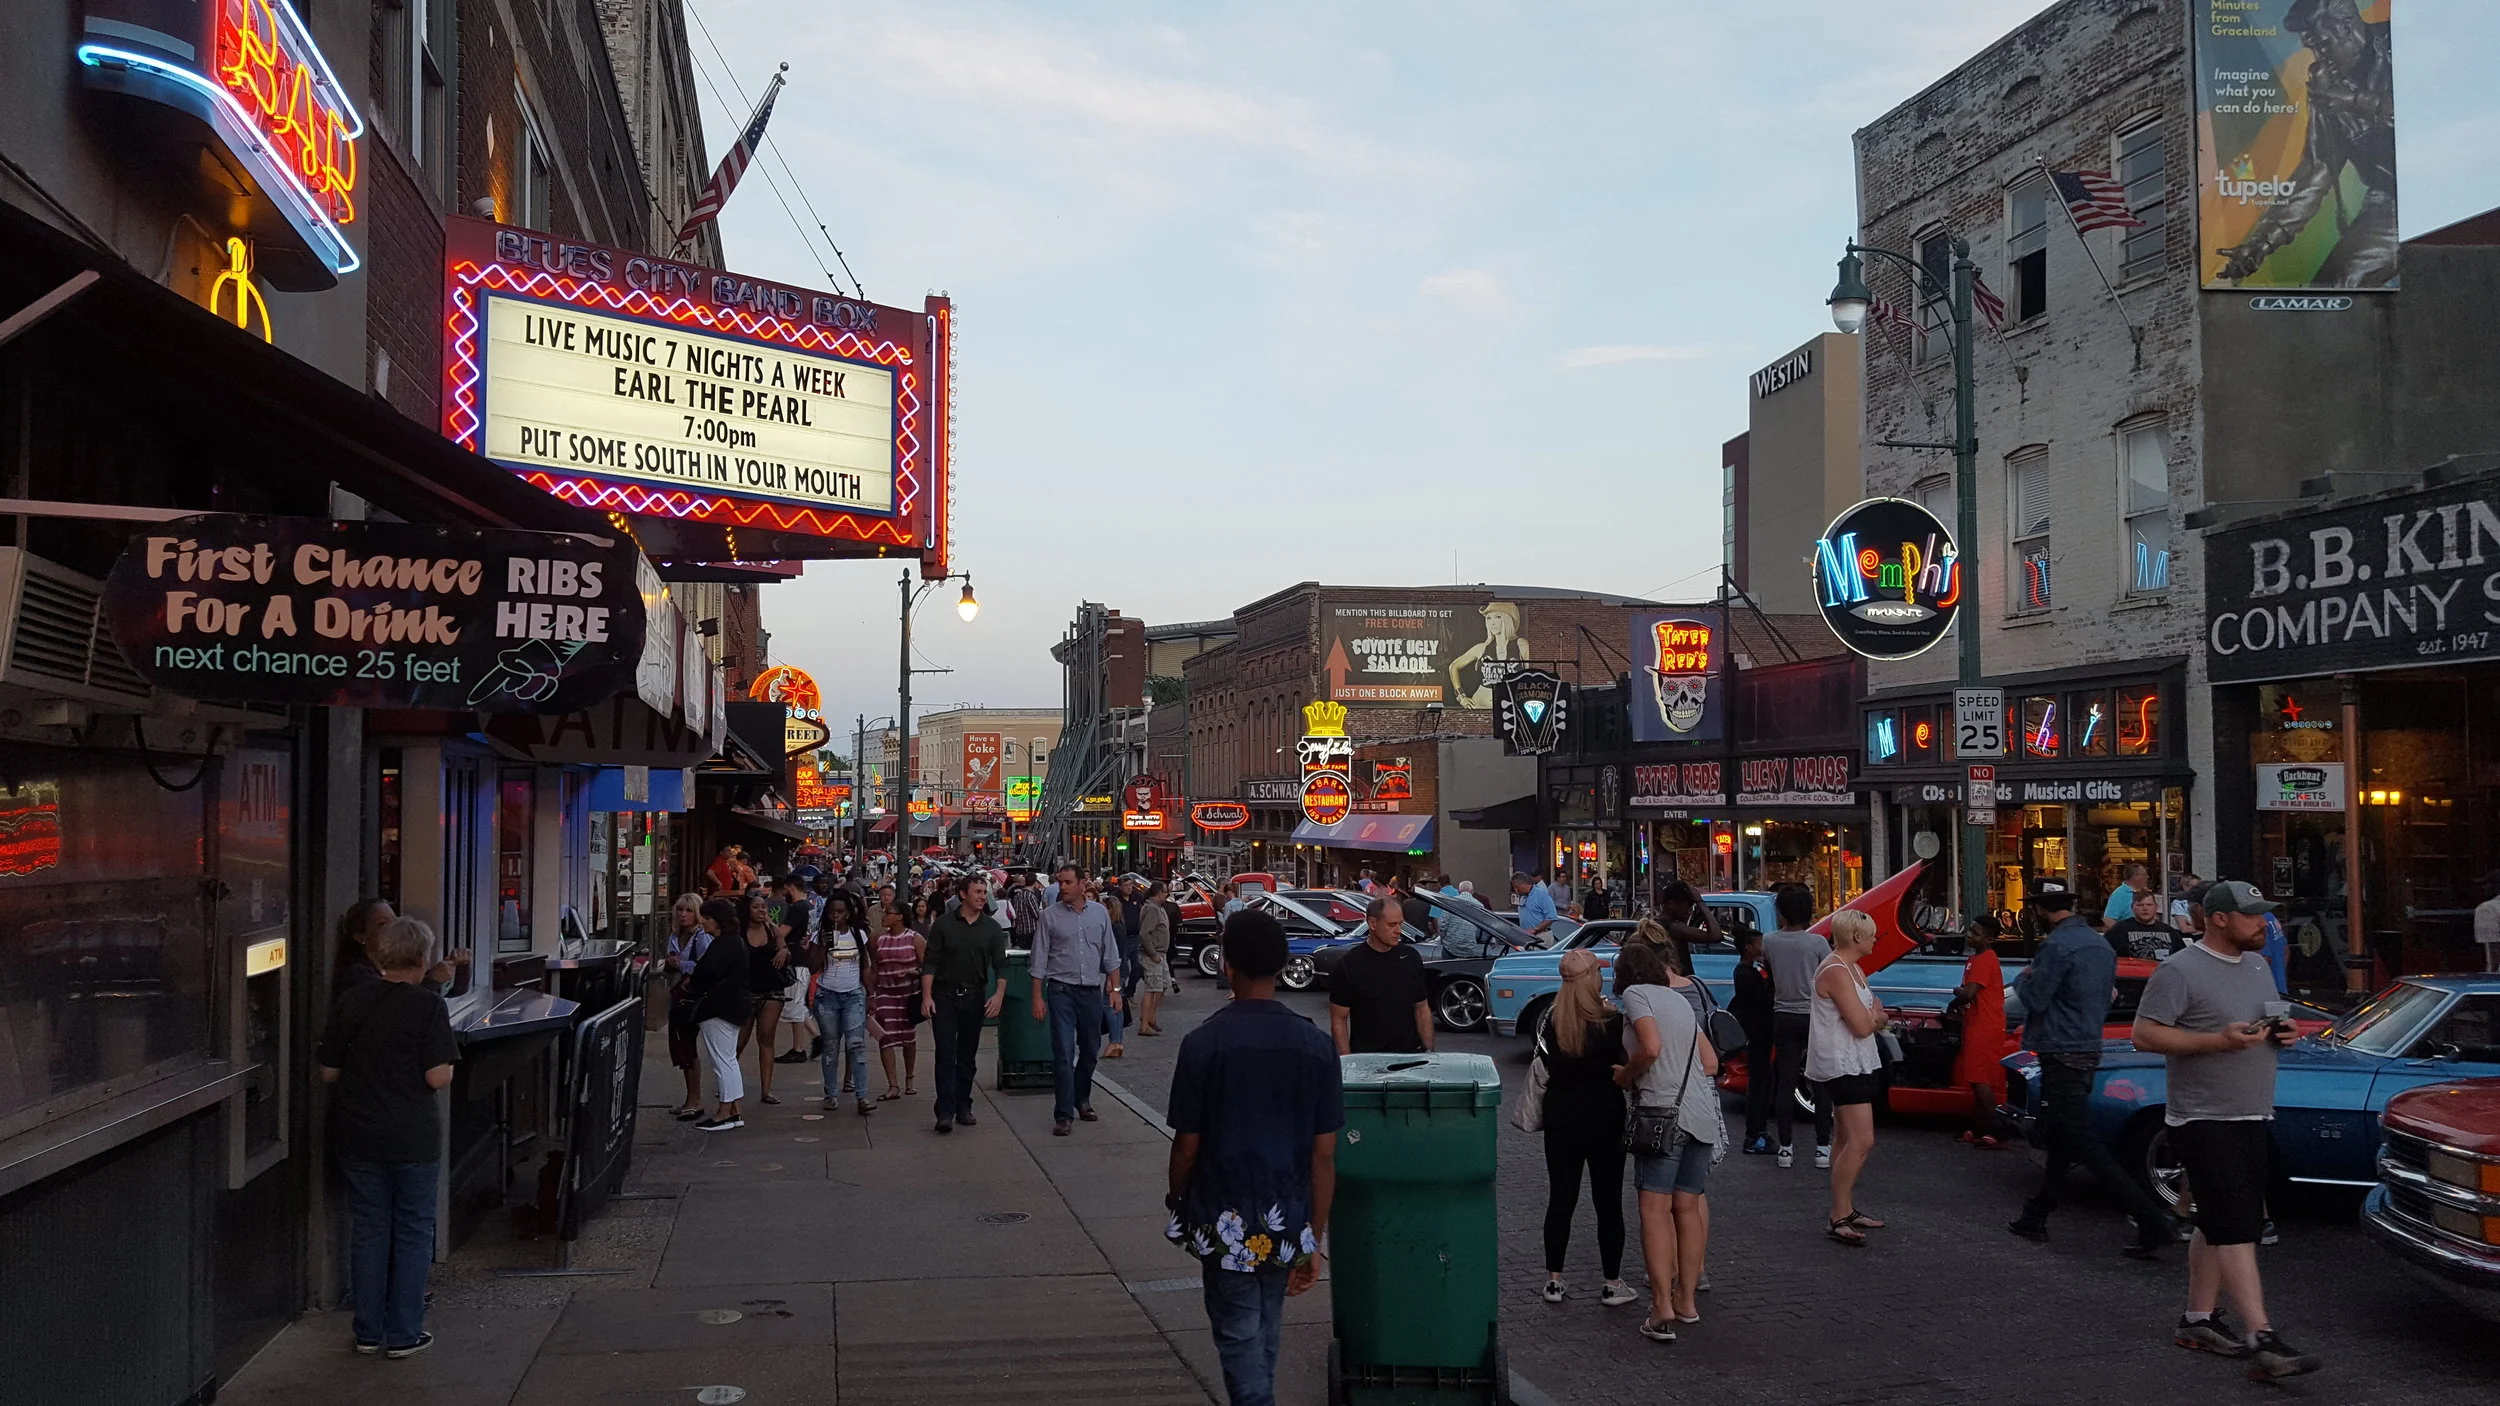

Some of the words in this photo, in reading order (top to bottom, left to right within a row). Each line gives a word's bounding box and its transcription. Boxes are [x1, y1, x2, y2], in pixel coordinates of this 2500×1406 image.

[2211, 13, 2241, 24] from
[2211, 25, 2277, 37] Graceland
[2214, 68, 2269, 83] Imagine
[2215, 85, 2249, 97] what
[2252, 87, 2276, 98] you
[2215, 103, 2239, 113] can
[2243, 101, 2260, 113] do
[2263, 101, 2299, 114] here!
[2215, 170, 2296, 206] tupelo
[495, 230, 614, 283] BLUES
[625, 257, 700, 299] CITY
[711, 276, 803, 320] BAND
[812, 297, 878, 337] BOX
[2258, 298, 2343, 310] LAMAR
[524, 315, 576, 351] LIVE
[584, 324, 657, 368] MUSIC
[664, 341, 678, 368] 7
[686, 343, 764, 386] NIGHTS
[770, 360, 785, 389] A
[792, 364, 846, 400] WEEK
[1755, 350, 1812, 399] WESTIN
[613, 367, 677, 404] EARL
[684, 378, 734, 416] THE
[741, 388, 813, 428] PEARL
[683, 415, 757, 448] 7:00pm
[520, 425, 561, 461] PUT
[568, 432, 628, 469] SOME
[634, 442, 702, 481] SOUTH
[707, 453, 728, 484] IN
[734, 457, 788, 492] YOUR
[794, 466, 862, 501] MOUTH
[146, 535, 276, 585] First
[293, 542, 483, 597] Chance
[1815, 532, 1962, 608] Memphis
[2249, 526, 2372, 600] B.B.
[507, 556, 604, 600] RIBS
[165, 590, 252, 636] For
[261, 595, 298, 641] A
[313, 597, 462, 647] Drink
[495, 600, 611, 643] HERE
[1335, 608, 1368, 617] MENTION
[1369, 609, 1387, 617] THIS
[1388, 609, 1427, 618] BILLBOARD
[1428, 610, 1438, 618] TO
[1439, 610, 1453, 618] GET
[2210, 577, 2464, 656] COMPANY
[1365, 618, 1389, 629] FREE
[1391, 618, 1424, 629] COVER
[1660, 624, 1710, 647] TATER
[2416, 636, 2447, 655] est.
[2451, 631, 2489, 652] 1947
[1351, 637, 1403, 656] COYOTE
[1406, 639, 1439, 656] UGLY
[155, 644, 225, 672] next
[232, 646, 348, 678] chance
[356, 650, 396, 679] 25
[404, 652, 461, 684] feet
[1367, 655, 1429, 672] SALOON
[1335, 688, 1357, 698] JUST
[1359, 688, 1376, 698] ONE
[1379, 688, 1408, 698] BLOCK
[1410, 688, 1438, 698] AWAY!
[1517, 682, 1551, 690] BLACK
[1516, 690, 1553, 700] DIAMOND
[1958, 696, 1999, 708] SPEED
[1963, 710, 1995, 722] LIMIT
[969, 734, 987, 742] Have
[1960, 725, 1999, 750] 25
[968, 743, 995, 754] Coke
[1635, 764, 1678, 795] TATER
[1682, 761, 1720, 796] RED'S
[1742, 757, 1788, 793] LUCKY
[1793, 755, 1849, 793] MOJOS
[1973, 768, 1989, 778] NO
[812, 787, 849, 796] PALACE
[1315, 777, 1337, 789] BAR
[2024, 781, 2083, 800] Musical
[2085, 780, 2122, 800] Gifts
[238, 764, 278, 823] ATM
[1304, 794, 1348, 806] RESTAURANT
[1922, 784, 1945, 801] CDs
[2278, 791, 2327, 800] TICKETS
[797, 797, 834, 807] CAFE
[1207, 807, 1243, 819] Schwab
[1664, 810, 1688, 818] ENTER
[2249, 886, 2262, 897] G
[269, 945, 285, 964] ATM
